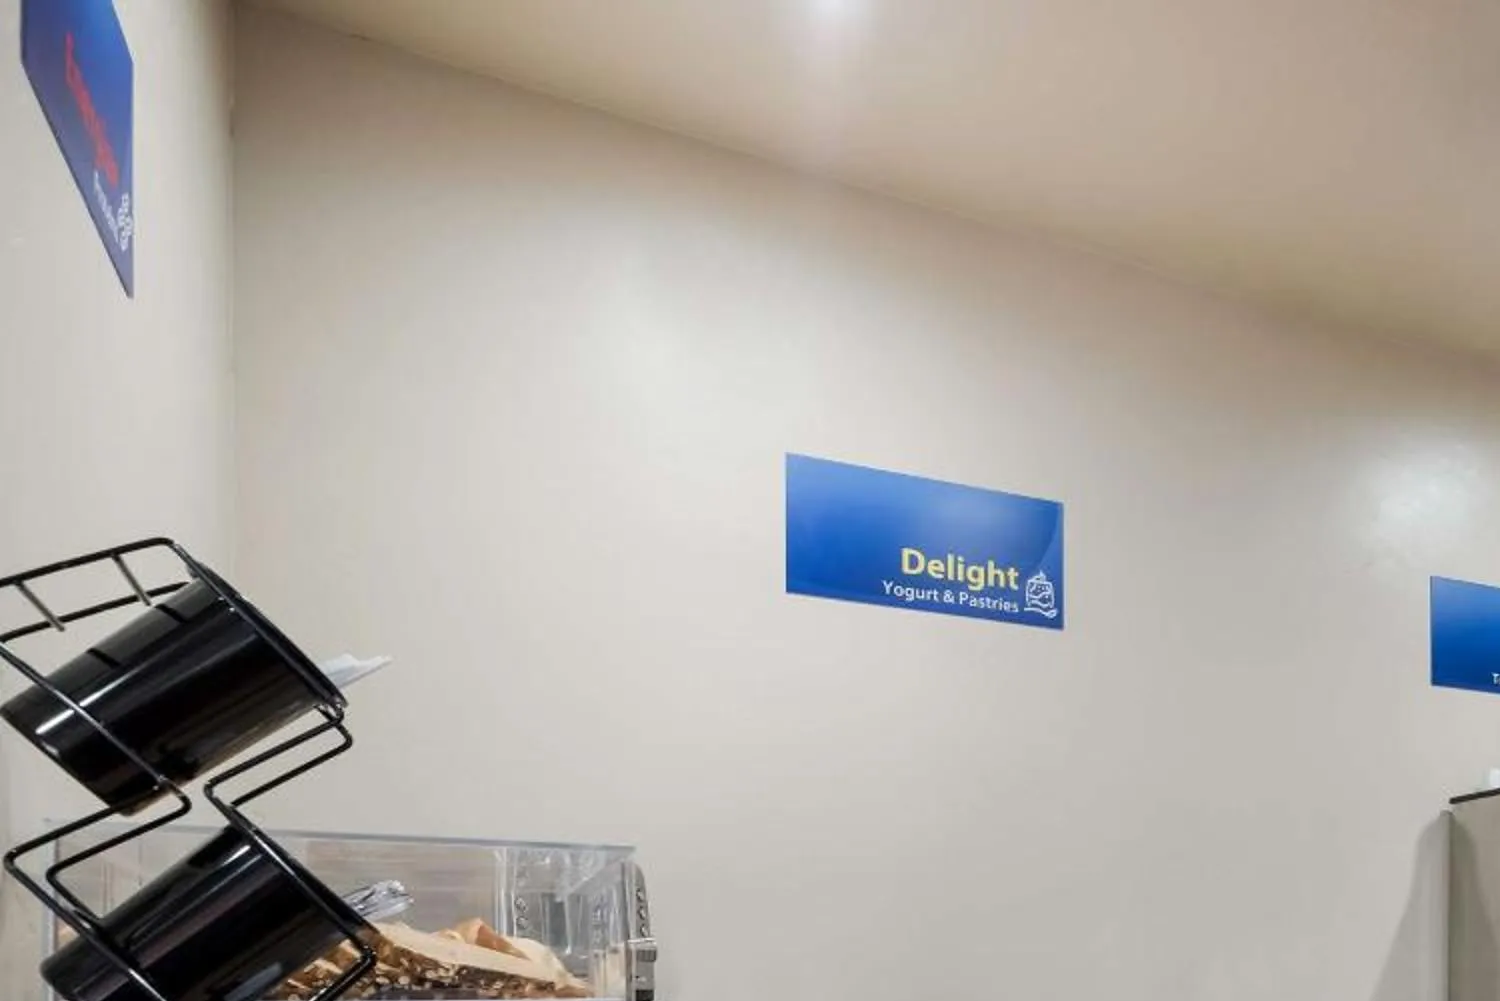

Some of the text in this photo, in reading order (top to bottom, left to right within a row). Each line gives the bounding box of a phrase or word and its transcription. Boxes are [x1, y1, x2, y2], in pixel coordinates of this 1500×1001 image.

[901, 547, 1019, 591] Delight
[882, 580, 1019, 613] Yogurt & Pastries
